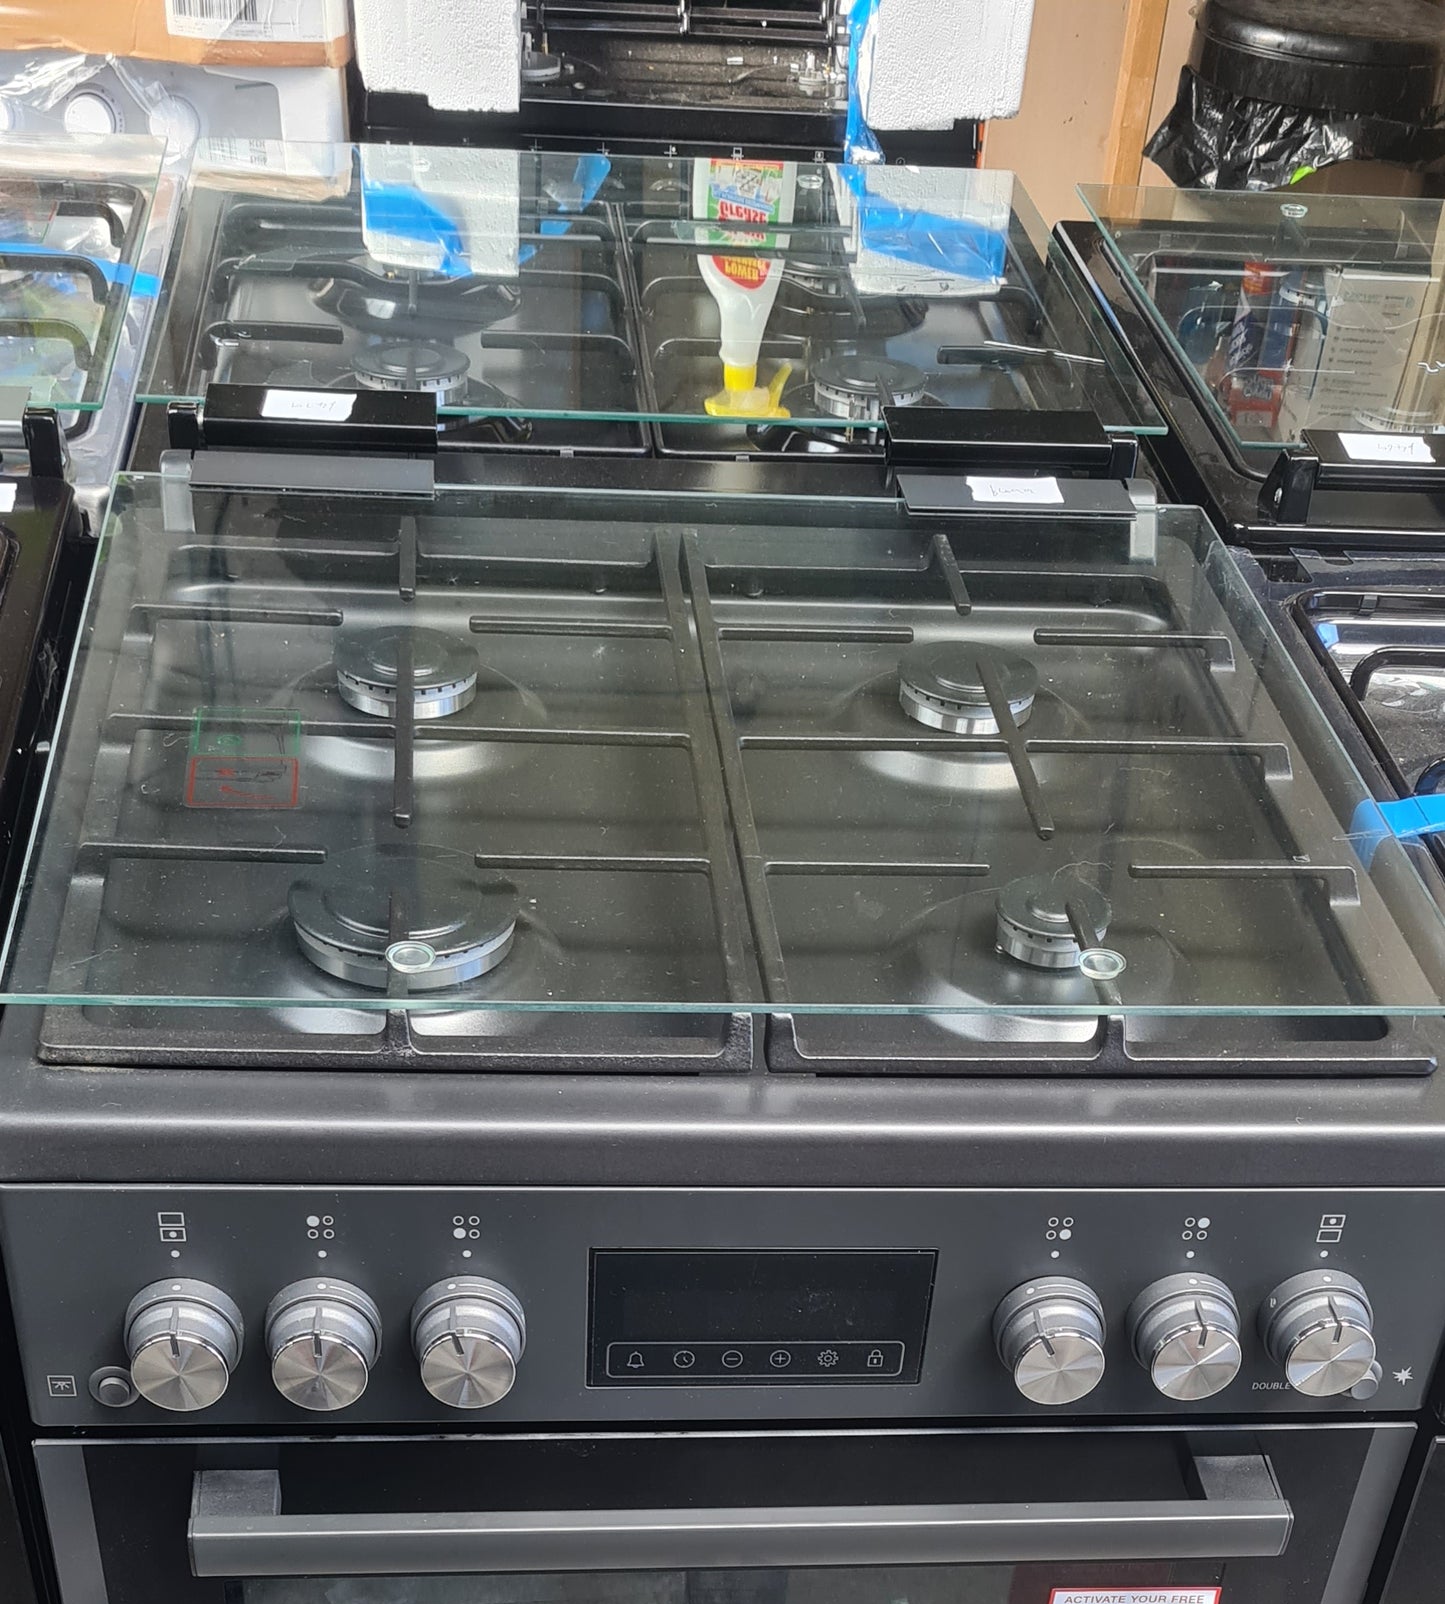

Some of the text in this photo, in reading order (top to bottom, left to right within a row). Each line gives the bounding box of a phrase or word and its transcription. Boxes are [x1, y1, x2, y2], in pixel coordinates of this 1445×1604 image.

[1252, 1382, 1291, 1390] DOUBLE
[1064, 1595, 1204, 1604] ACTIVATE YOUR FREE
